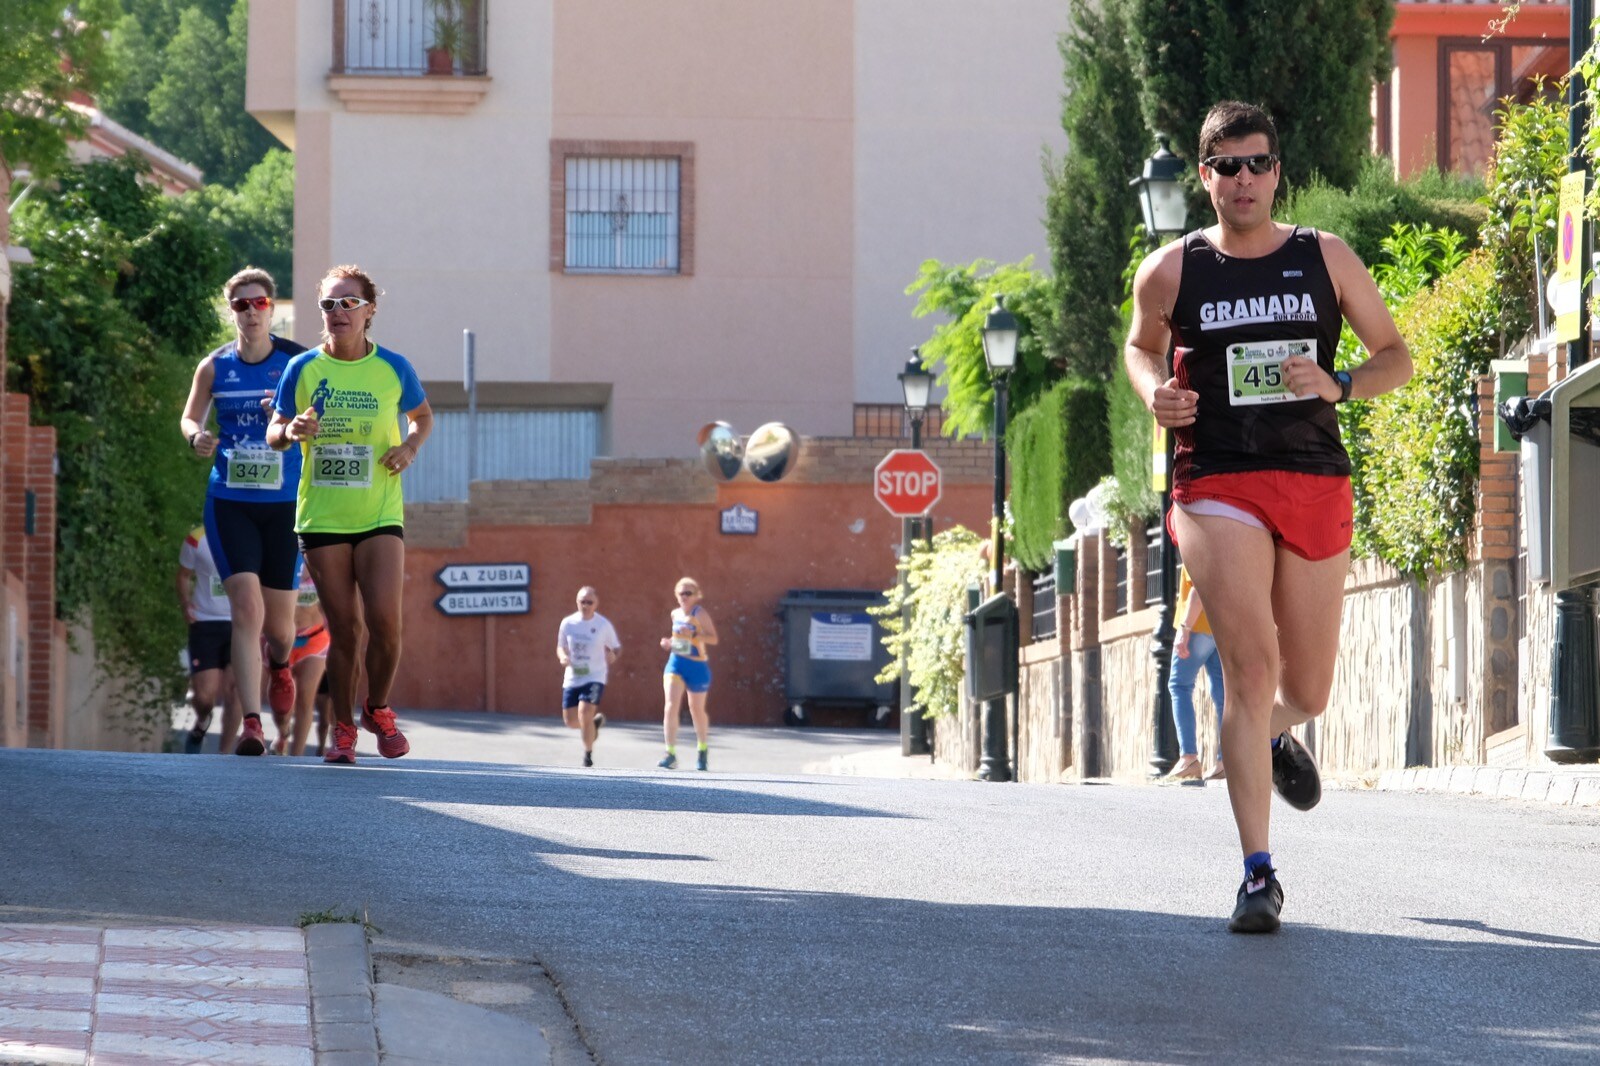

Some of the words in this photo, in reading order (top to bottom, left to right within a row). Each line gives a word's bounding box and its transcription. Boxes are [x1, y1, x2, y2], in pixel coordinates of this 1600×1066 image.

[1200, 294, 1315, 322] GRANADA
[1274, 313, 1288, 321] RUN
[325, 401, 344, 409] LUX
[346, 401, 379, 410] MUNDI
[334, 395, 378, 403] SOLIDARIA
[236, 463, 271, 478] 347
[321, 459, 360, 476] 228
[879, 470, 937, 496] STOP
[450, 571, 469, 582] LA
[477, 570, 523, 582] ZUBIA
[448, 595, 523, 609] BELLAVISTA
